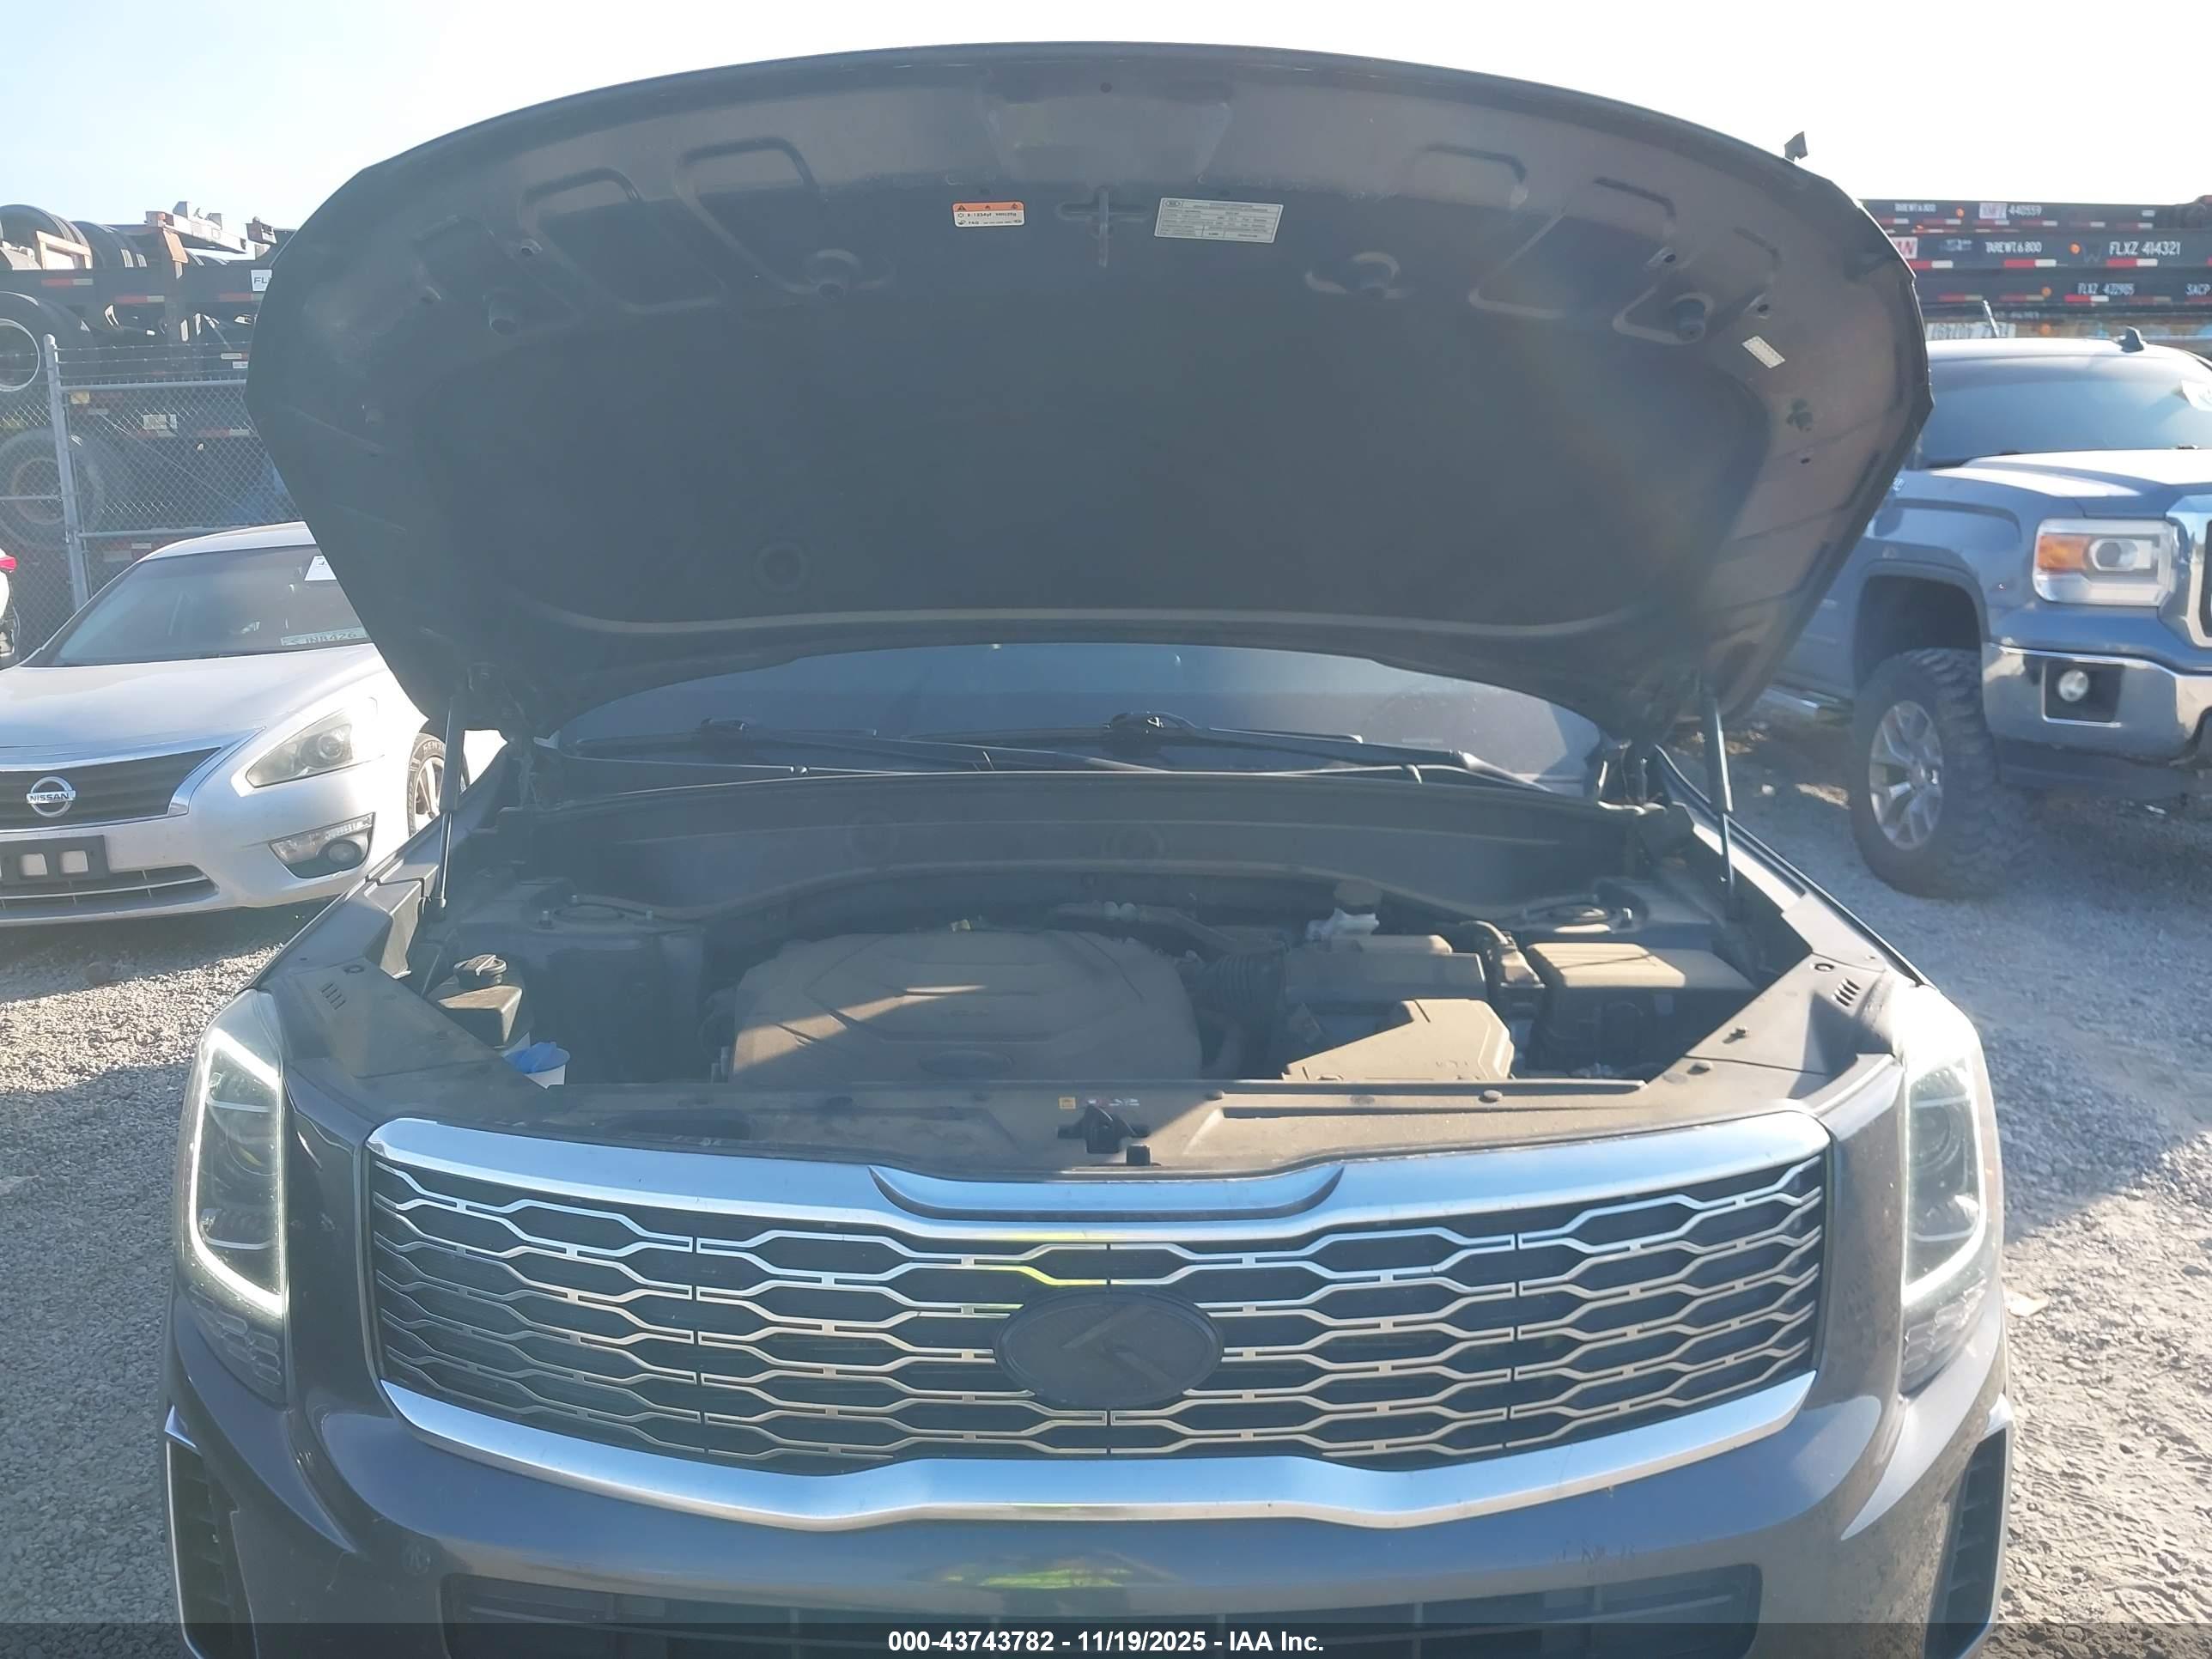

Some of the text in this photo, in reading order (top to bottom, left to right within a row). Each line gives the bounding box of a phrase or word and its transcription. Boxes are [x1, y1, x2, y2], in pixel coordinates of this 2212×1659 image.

[2108, 240, 2181, 256] FLXZ 414321
[29, 793, 70, 802] NISSAN
